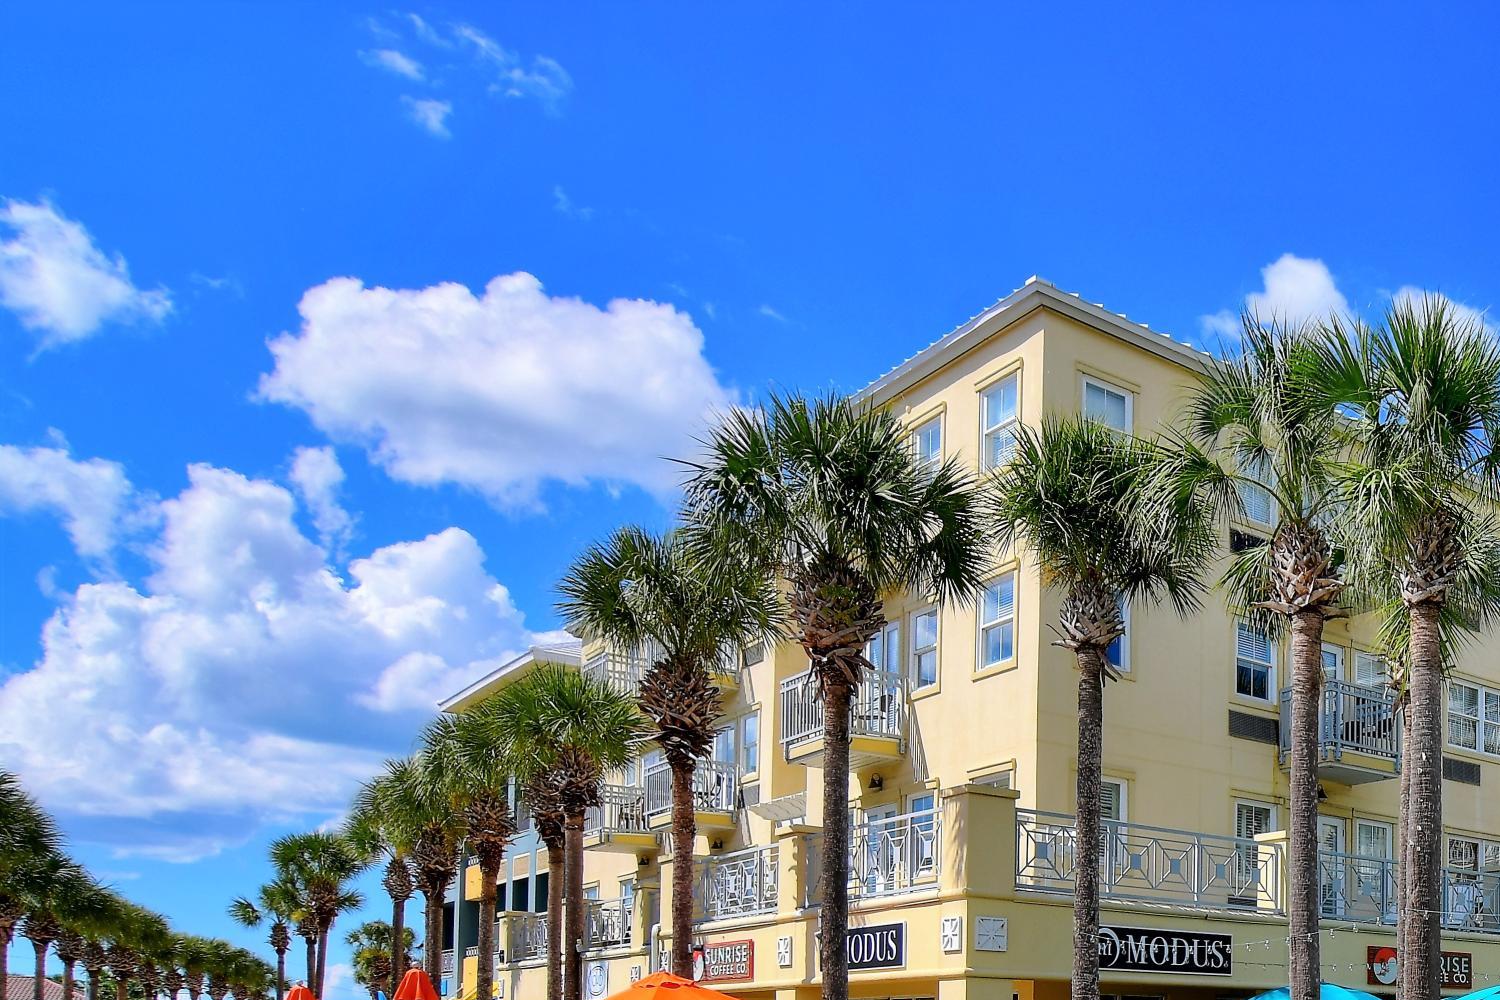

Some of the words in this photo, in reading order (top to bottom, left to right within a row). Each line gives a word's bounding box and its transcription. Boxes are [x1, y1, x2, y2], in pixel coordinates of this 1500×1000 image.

[705, 945, 748, 965] SUNRISE
[847, 930, 897, 963] ODUS
[1126, 934, 1224, 969] MODUS
[710, 963, 734, 976] COFFEE
[1440, 957, 1469, 973] RISE
[1453, 972, 1469, 984] CO.
